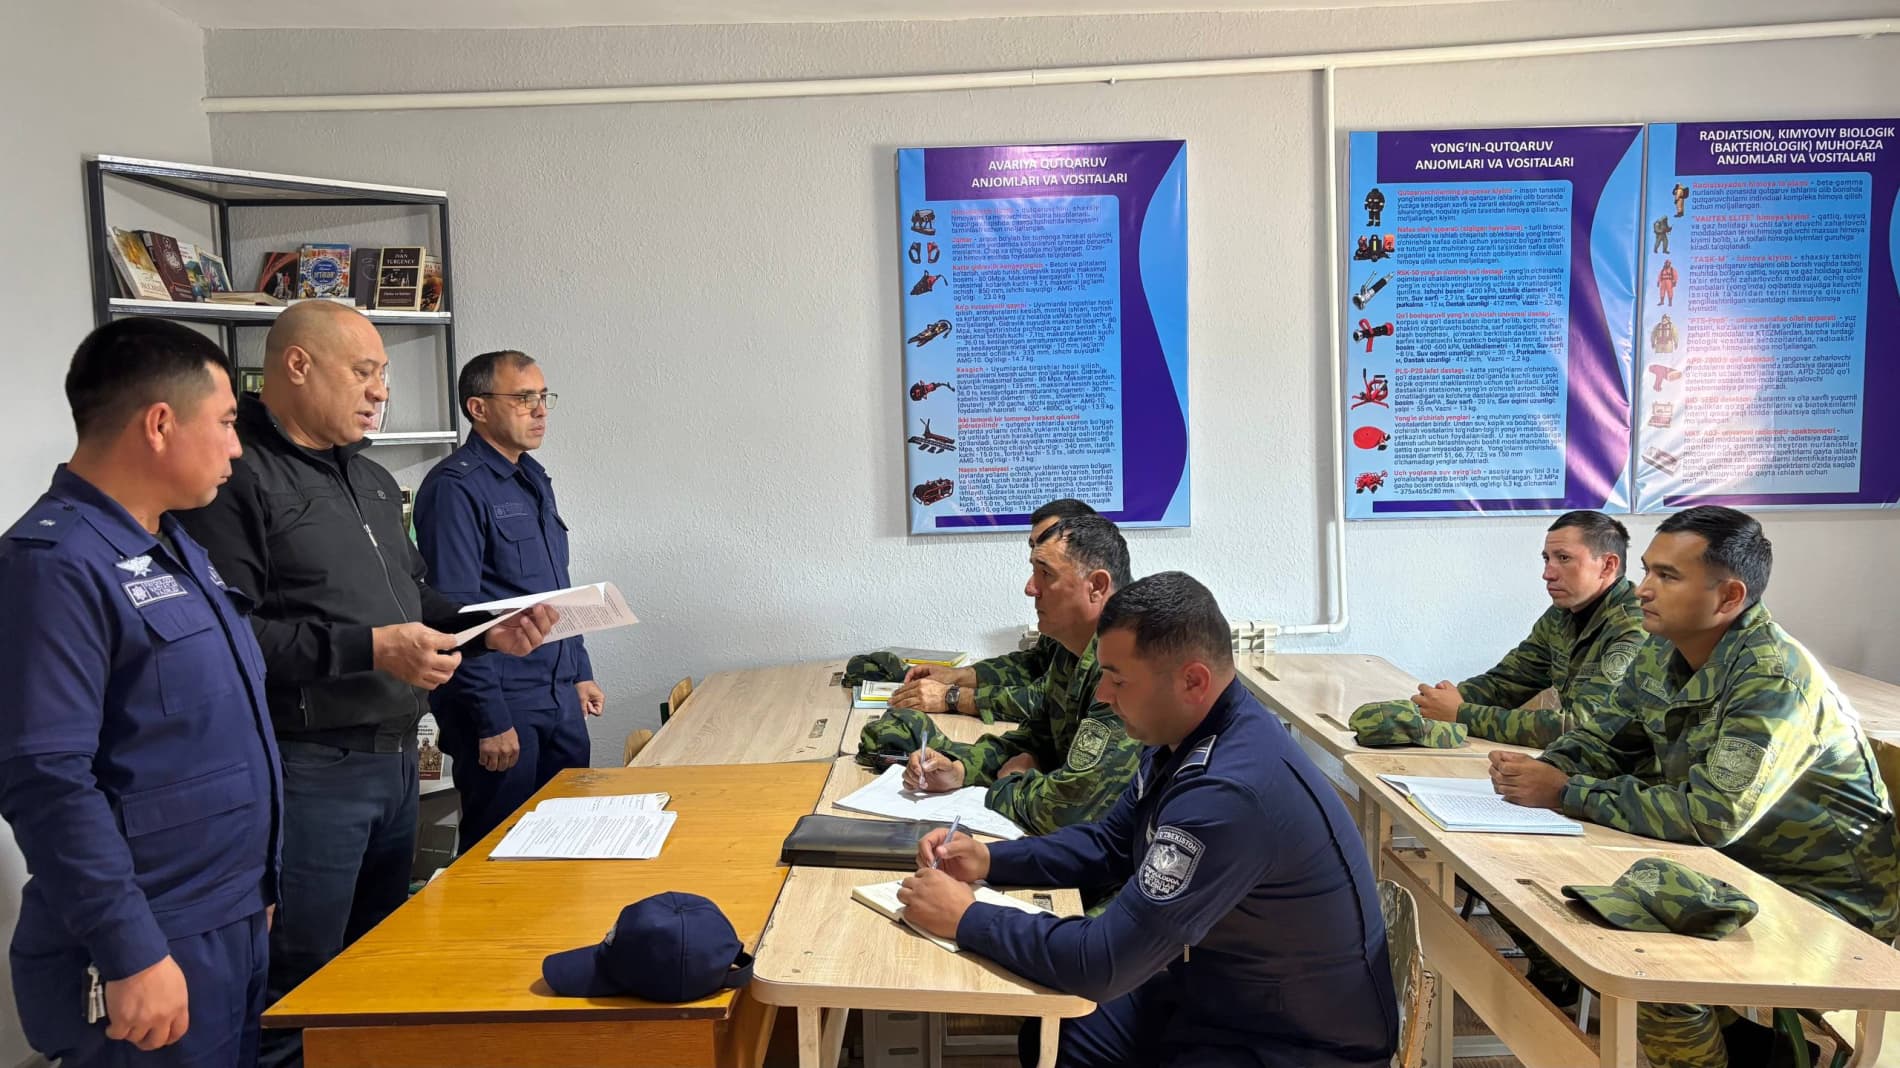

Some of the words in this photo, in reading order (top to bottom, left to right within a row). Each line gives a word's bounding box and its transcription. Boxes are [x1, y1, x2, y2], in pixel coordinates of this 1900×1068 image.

[1700, 130, 1774, 141] RADIATSION,
[1778, 128, 1836, 138] KIMYOVIY
[1840, 127, 1894, 138] BIOLOGIK
[1710, 141, 1812, 154] (BAKTERIOLOGIK)
[1816, 140, 1883, 150] MUHOFAZA
[988, 160, 1037, 170] AVARIYA
[1040, 157, 1107, 169] QUTQARUV
[1415, 159, 1484, 170] ANJOMLARI
[1488, 158, 1503, 168] VA
[1506, 157, 1574, 168] VOSITALARI
[1717, 154, 1786, 165] ANJOMLARI
[1790, 153, 1806, 162] VA
[1809, 152, 1876, 162] VOSITALARI
[972, 176, 1039, 188] ANJOMLARI
[1043, 175, 1057, 185] VA
[1061, 173, 1128, 184] VOSITALARI
